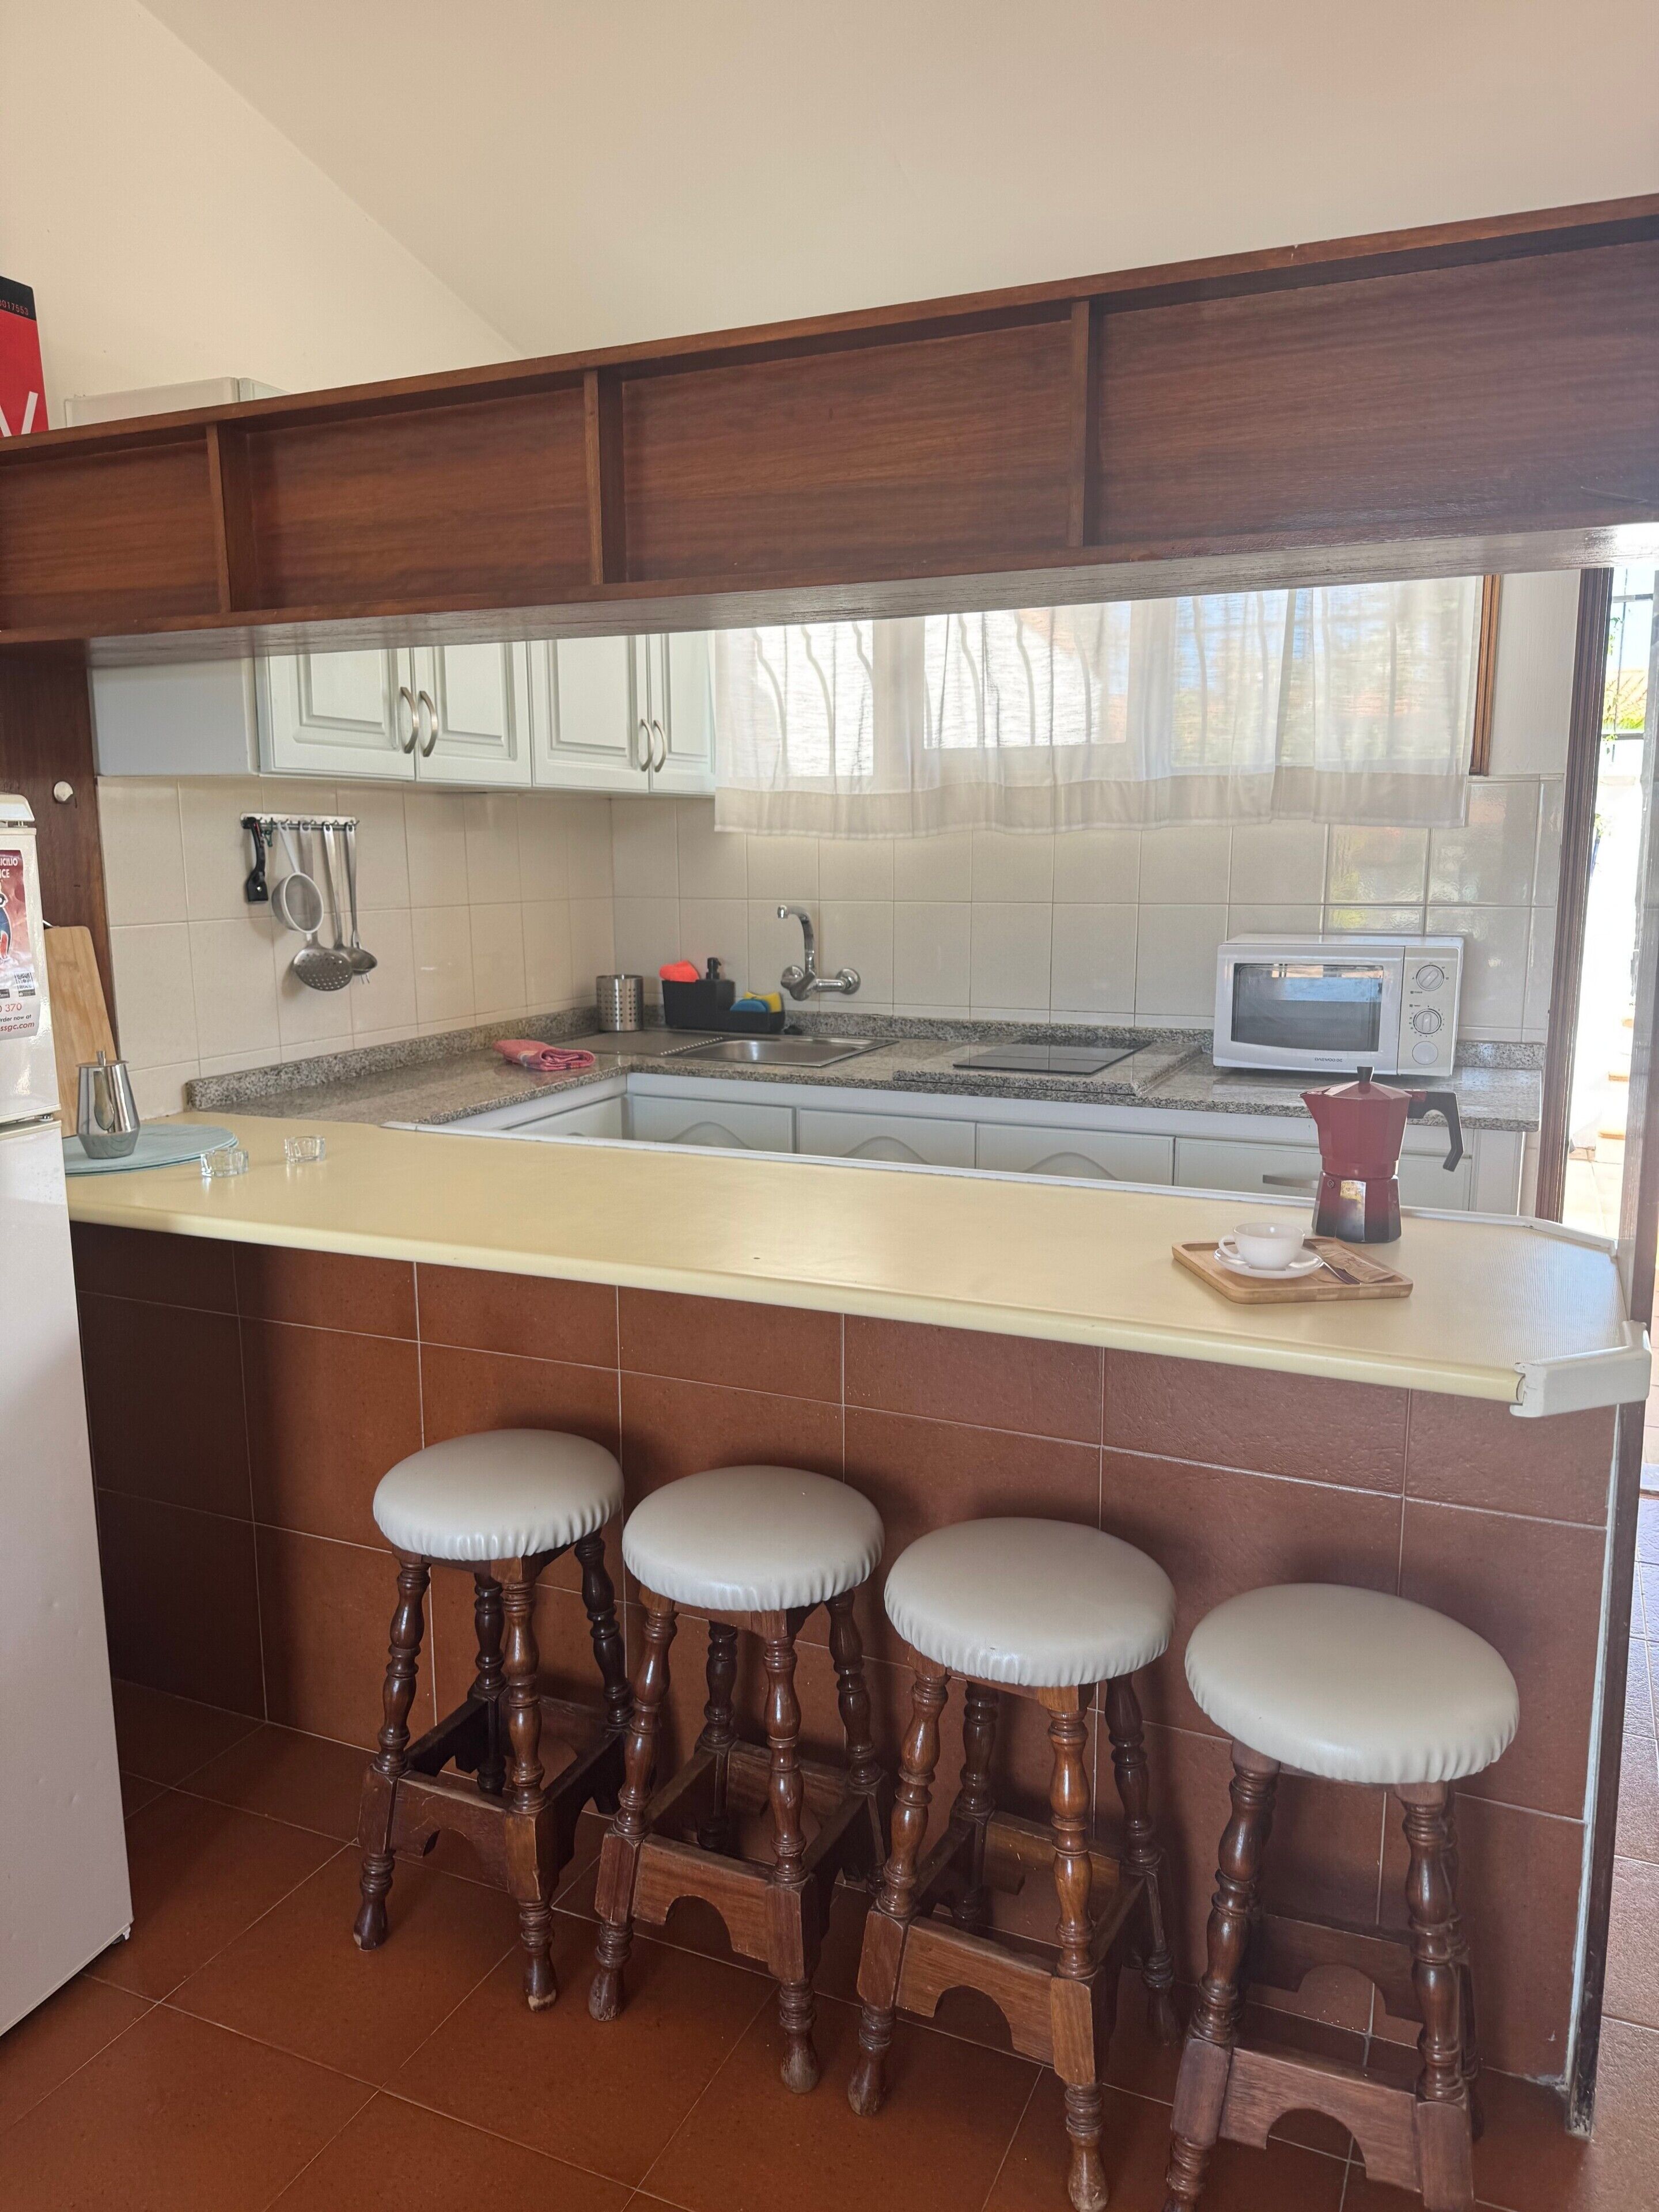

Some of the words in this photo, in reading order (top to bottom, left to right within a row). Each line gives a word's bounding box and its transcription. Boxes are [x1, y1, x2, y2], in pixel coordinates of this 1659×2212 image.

[0, 300, 29, 316] 017553
[0, 858, 18, 866] ICILIO
[5, 1003, 22, 1012] 370
[0, 1022, 35, 1032] ssgc.com
